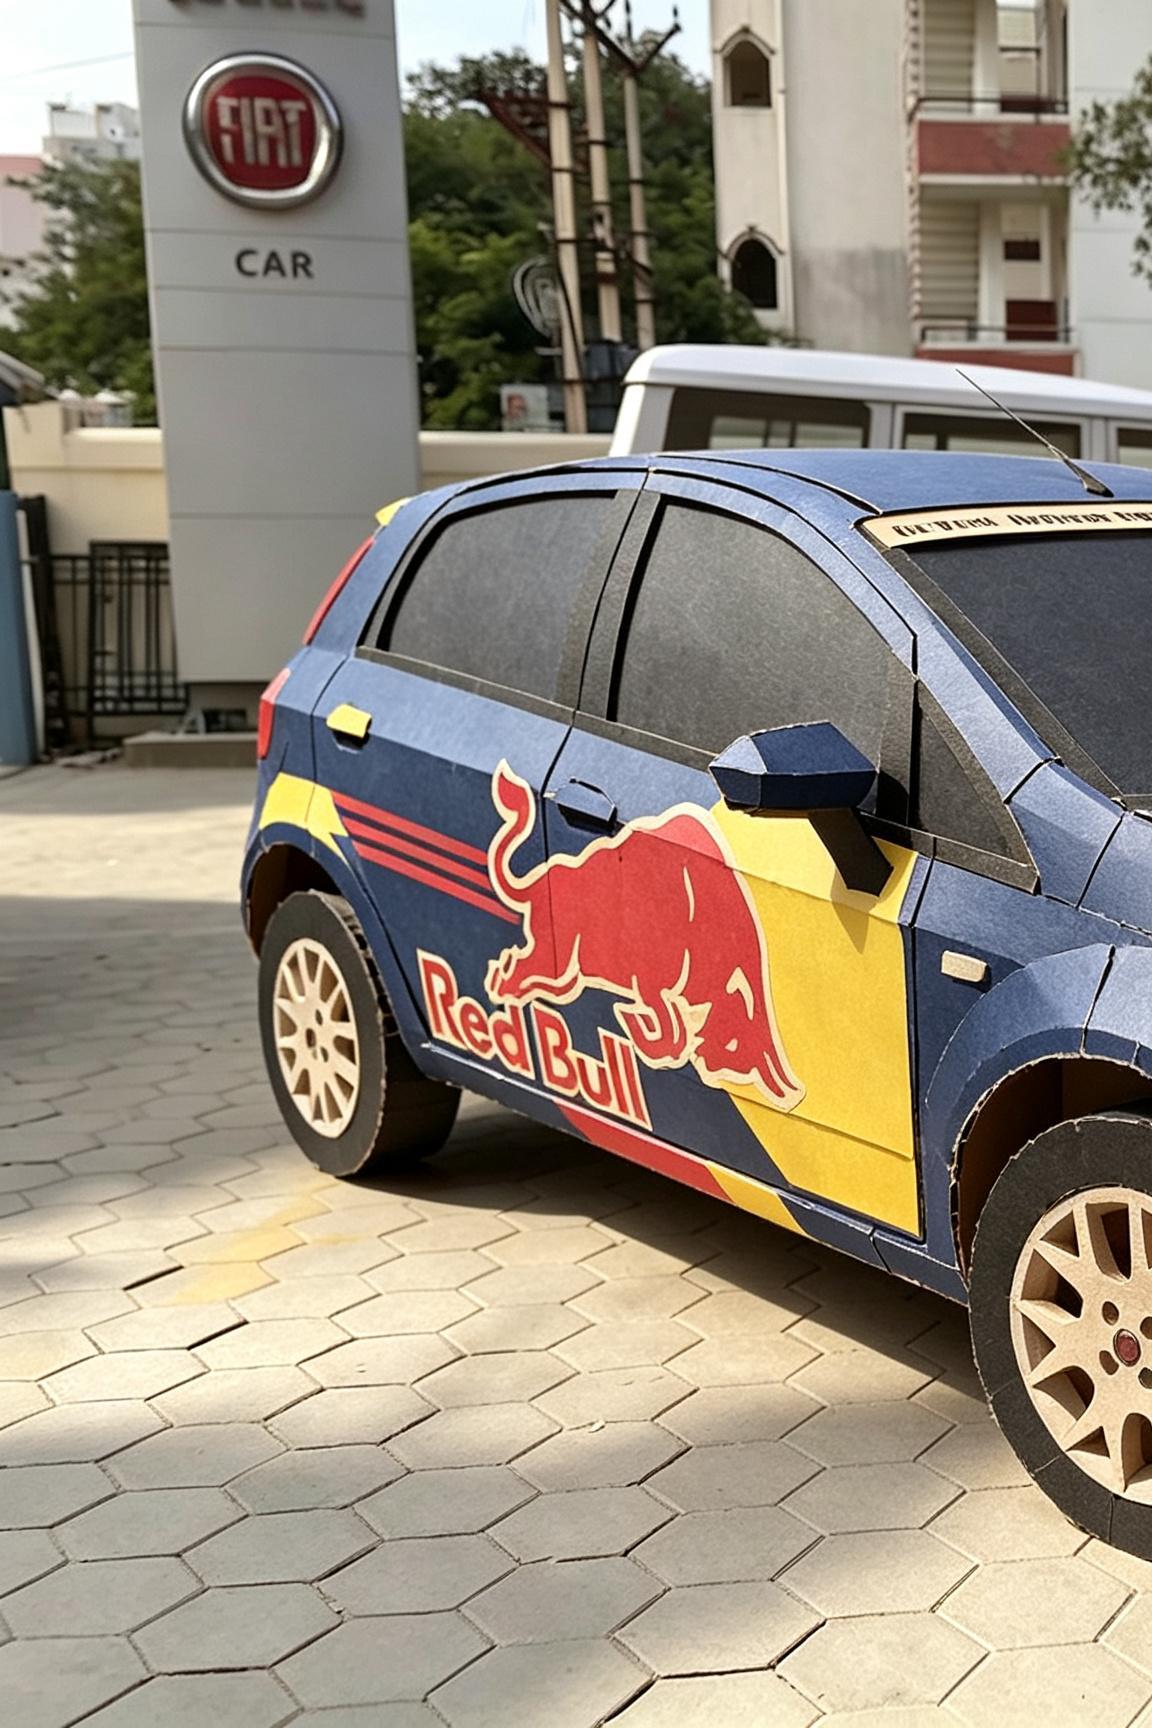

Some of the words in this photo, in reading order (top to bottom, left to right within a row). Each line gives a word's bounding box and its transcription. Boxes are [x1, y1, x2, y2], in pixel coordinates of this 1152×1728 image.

[215, 96, 307, 169] FIAT
[235, 248, 315, 280] CAR
[416, 948, 536, 1081] Red
[530, 1000, 653, 1132] Bull
